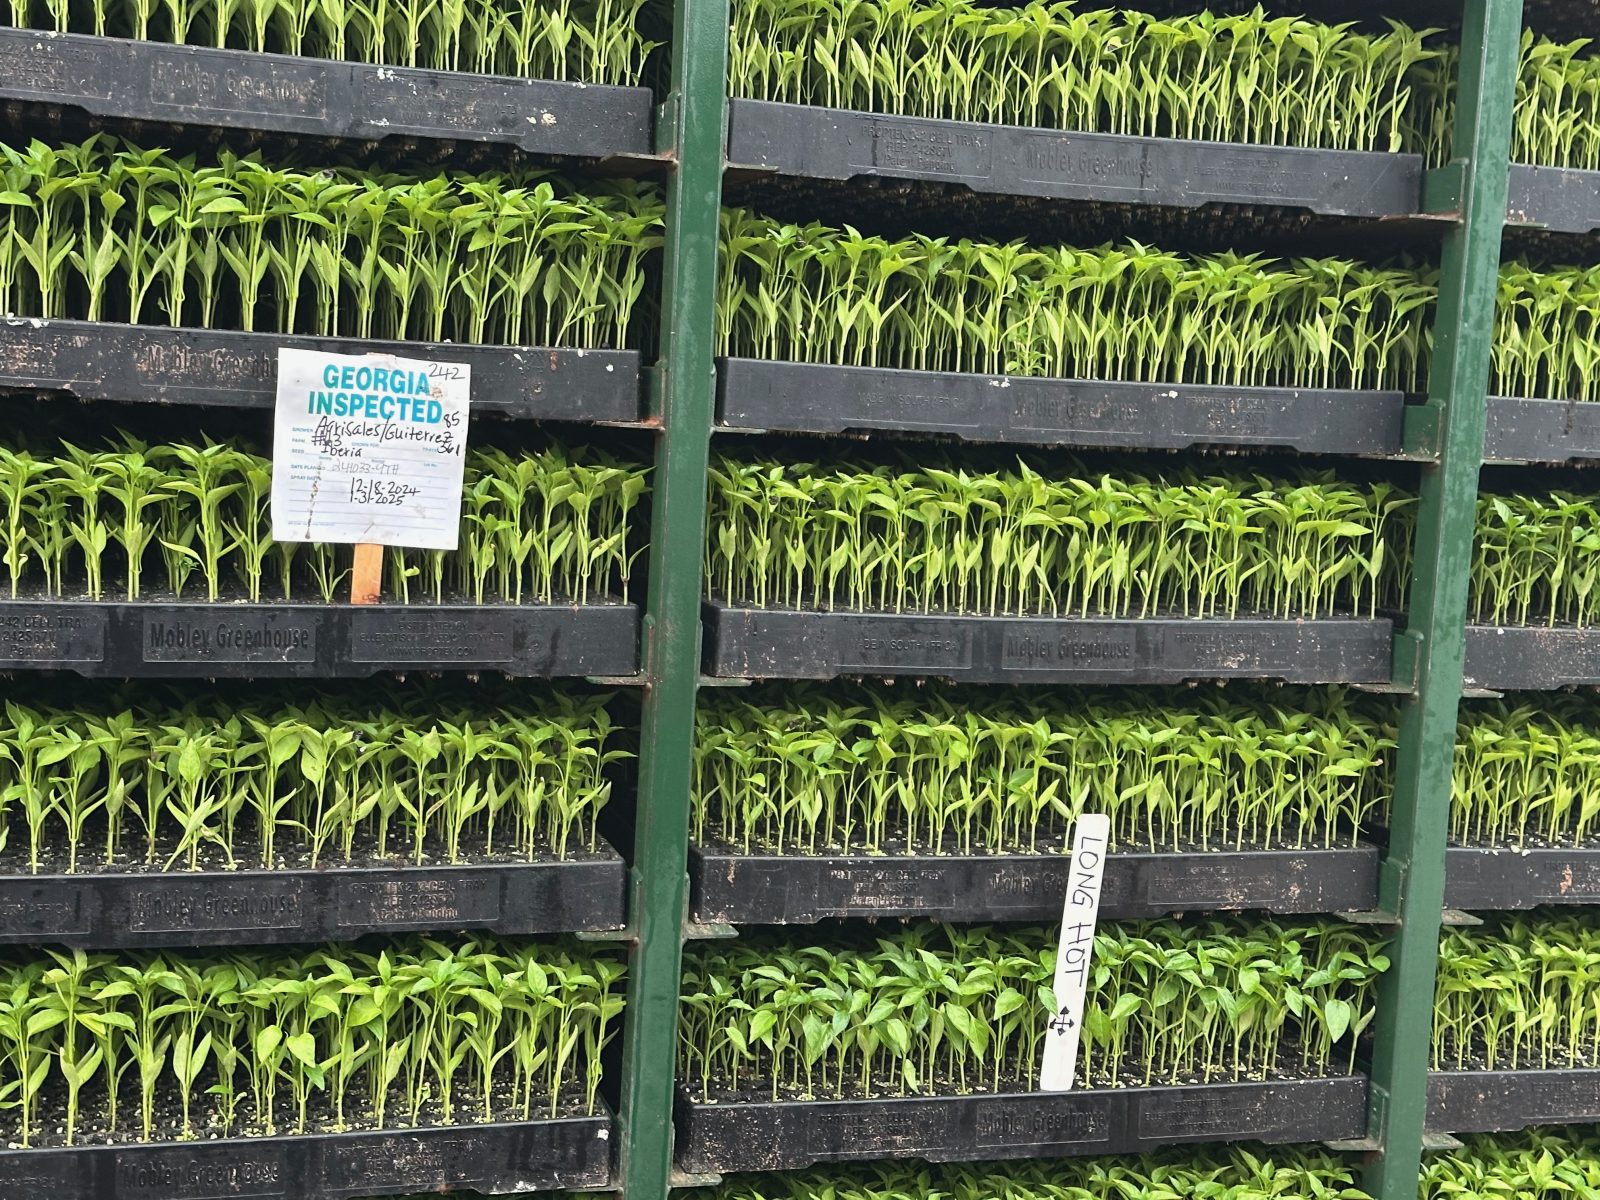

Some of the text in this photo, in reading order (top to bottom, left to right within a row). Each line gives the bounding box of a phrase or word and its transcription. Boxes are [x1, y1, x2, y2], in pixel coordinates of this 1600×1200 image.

[323, 364, 430, 396] GEORGIA
[428, 363, 466, 381] 242
[308, 391, 442, 424] INSPECTED
[443, 411, 461, 428] 85
[350, 476, 421, 497] 12-18-2024
[151, 622, 311, 653] Mobley Greenhouse
[1064, 836, 1103, 988] LONG HOT
